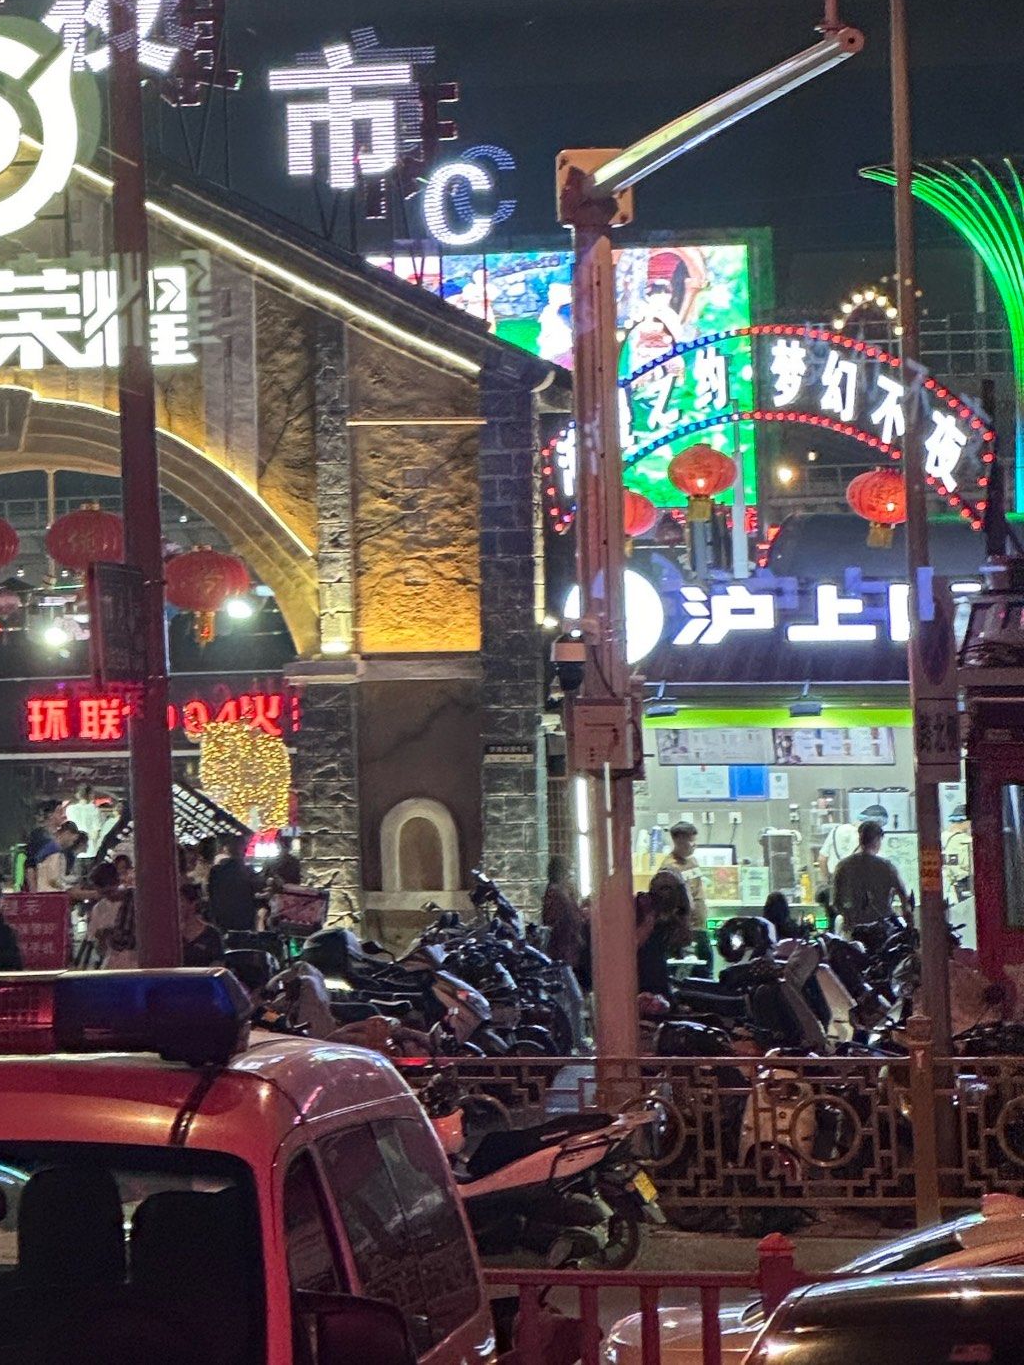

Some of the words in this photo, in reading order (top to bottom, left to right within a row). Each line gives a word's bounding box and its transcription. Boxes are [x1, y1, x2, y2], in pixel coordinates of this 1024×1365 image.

[423, 162, 494, 245] C
[772, 339, 967, 493] 梦幻不夜
